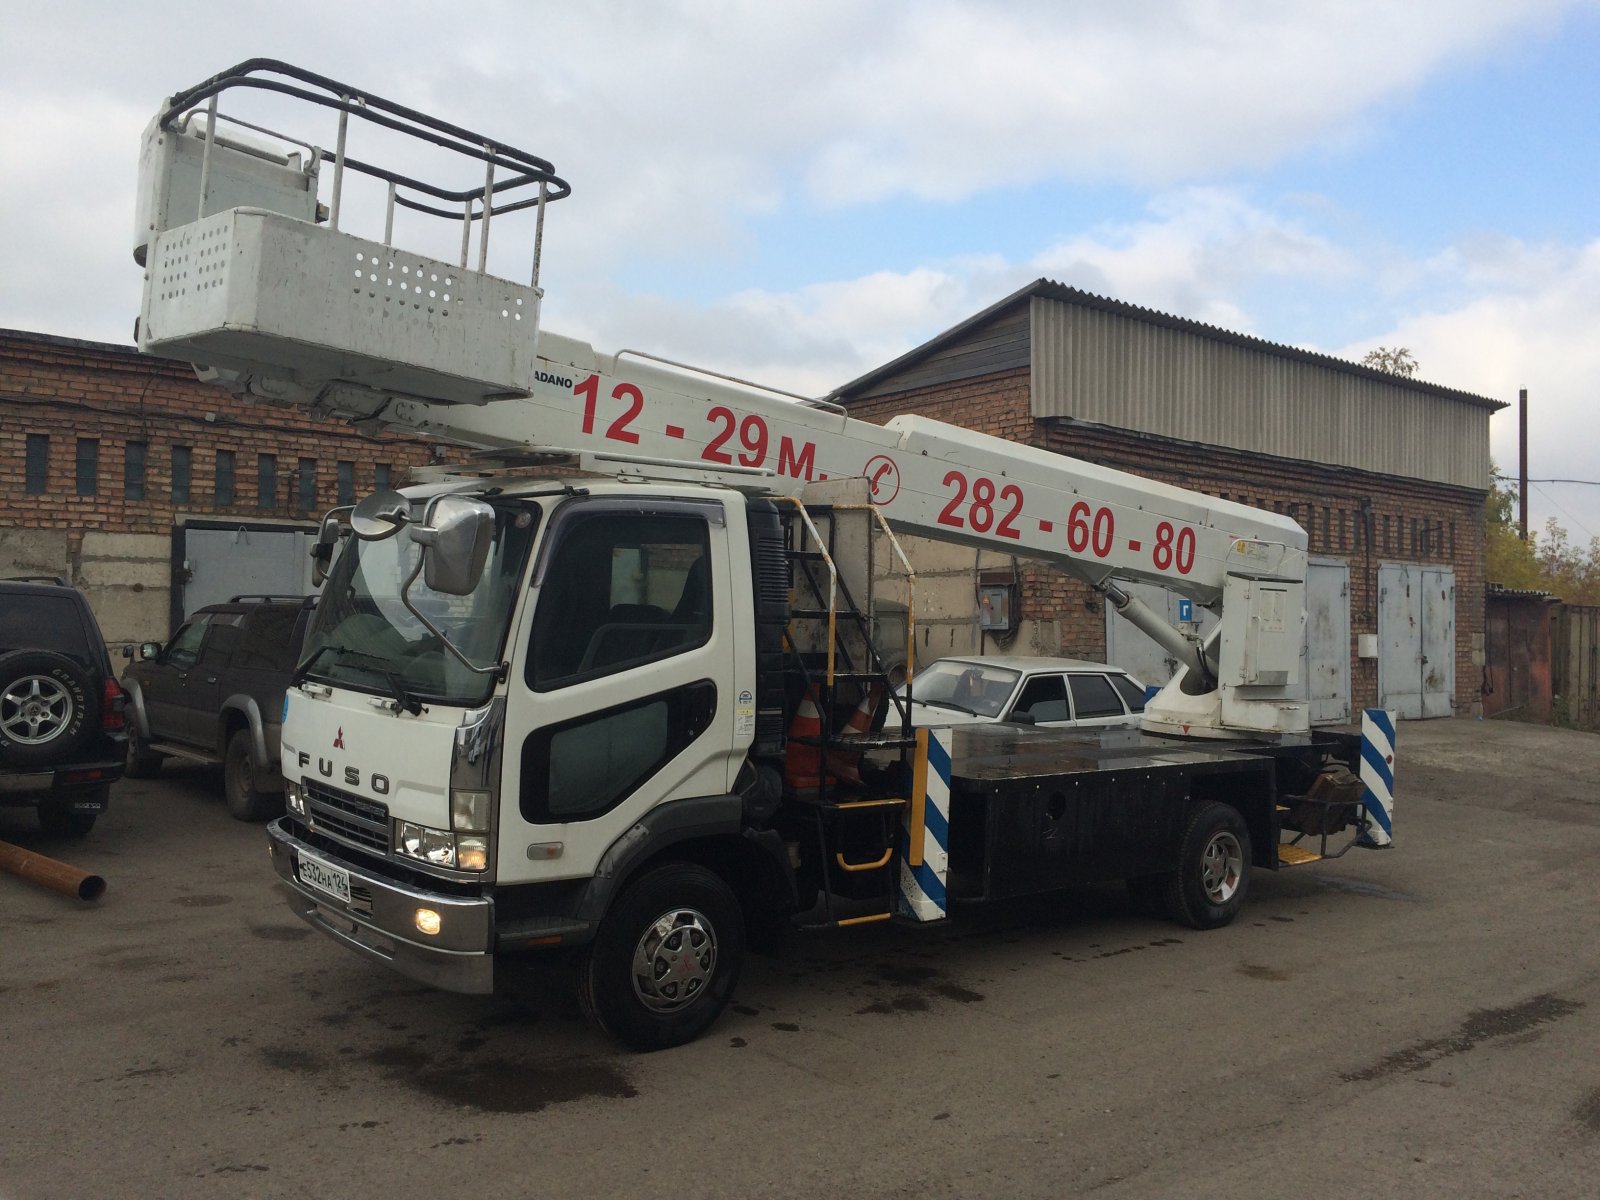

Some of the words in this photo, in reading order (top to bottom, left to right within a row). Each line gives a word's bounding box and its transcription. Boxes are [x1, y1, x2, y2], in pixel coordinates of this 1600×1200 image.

[573, 374, 645, 445] 12
[701, 406, 769, 469] 29
[937, 470, 1024, 540] 282
[1067, 501, 1115, 558] 60
[1152, 521, 1196, 575] 80
[298, 751, 390, 795] FUSO
